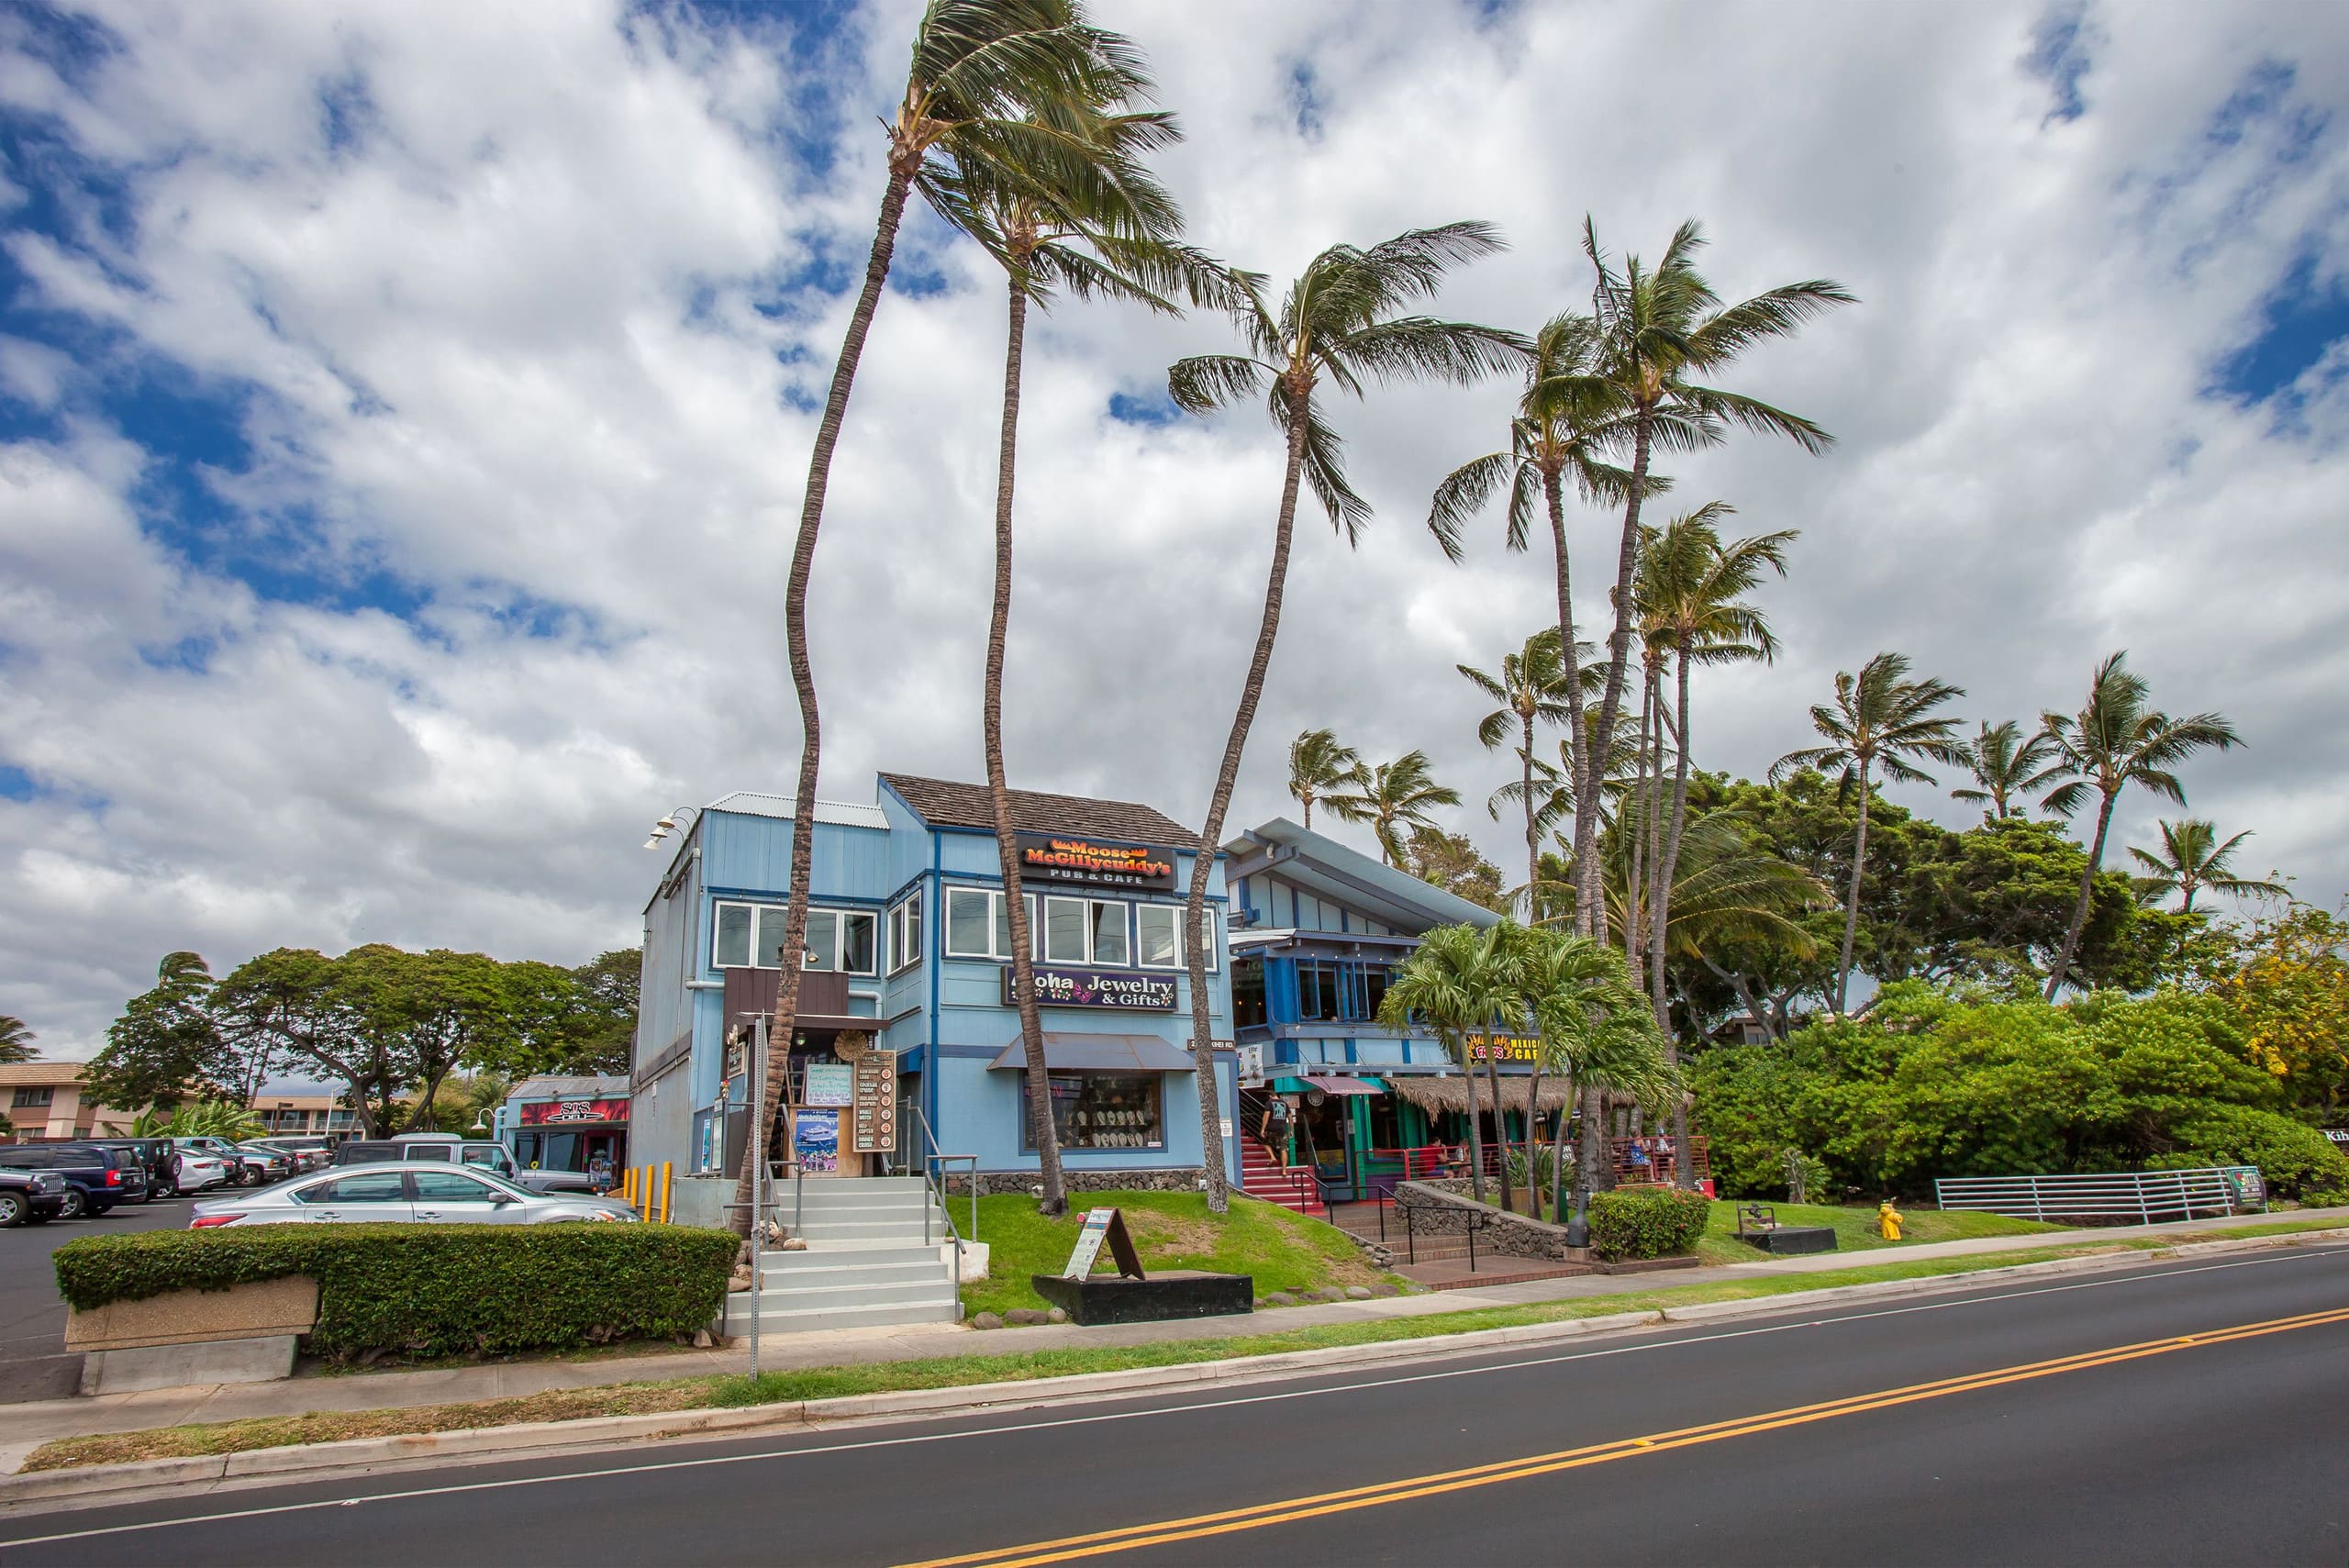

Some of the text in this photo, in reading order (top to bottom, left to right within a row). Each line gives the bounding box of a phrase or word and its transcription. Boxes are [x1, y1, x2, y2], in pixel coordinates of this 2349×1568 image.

[1071, 841, 1130, 859] Moose
[1027, 849, 1171, 874] McGillycuddy's
[1050, 869, 1143, 884] PUB & CAFE
[1087, 975, 1173, 996] Jewelry
[1102, 994, 1161, 1006] & Gifts
[1515, 1049, 1539, 1061] CAF
